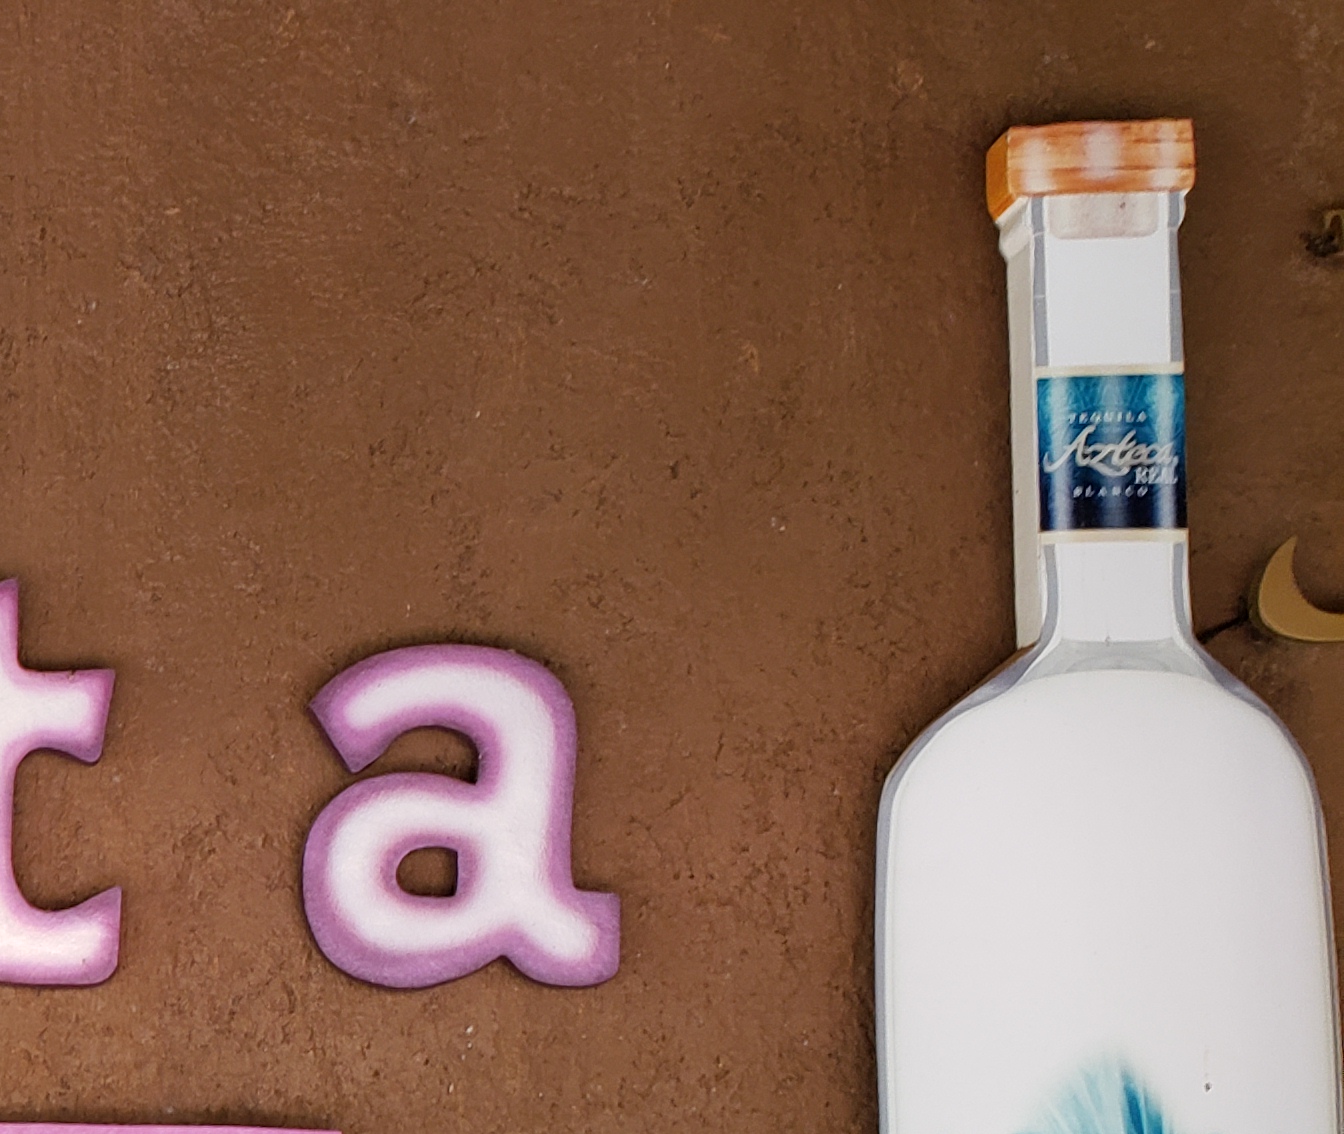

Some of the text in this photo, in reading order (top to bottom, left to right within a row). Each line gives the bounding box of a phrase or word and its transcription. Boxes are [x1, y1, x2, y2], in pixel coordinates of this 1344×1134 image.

[1068, 411, 1147, 424] TEQUILA
[1043, 424, 1178, 476] Azteca
[1134, 465, 1179, 484] REAL
